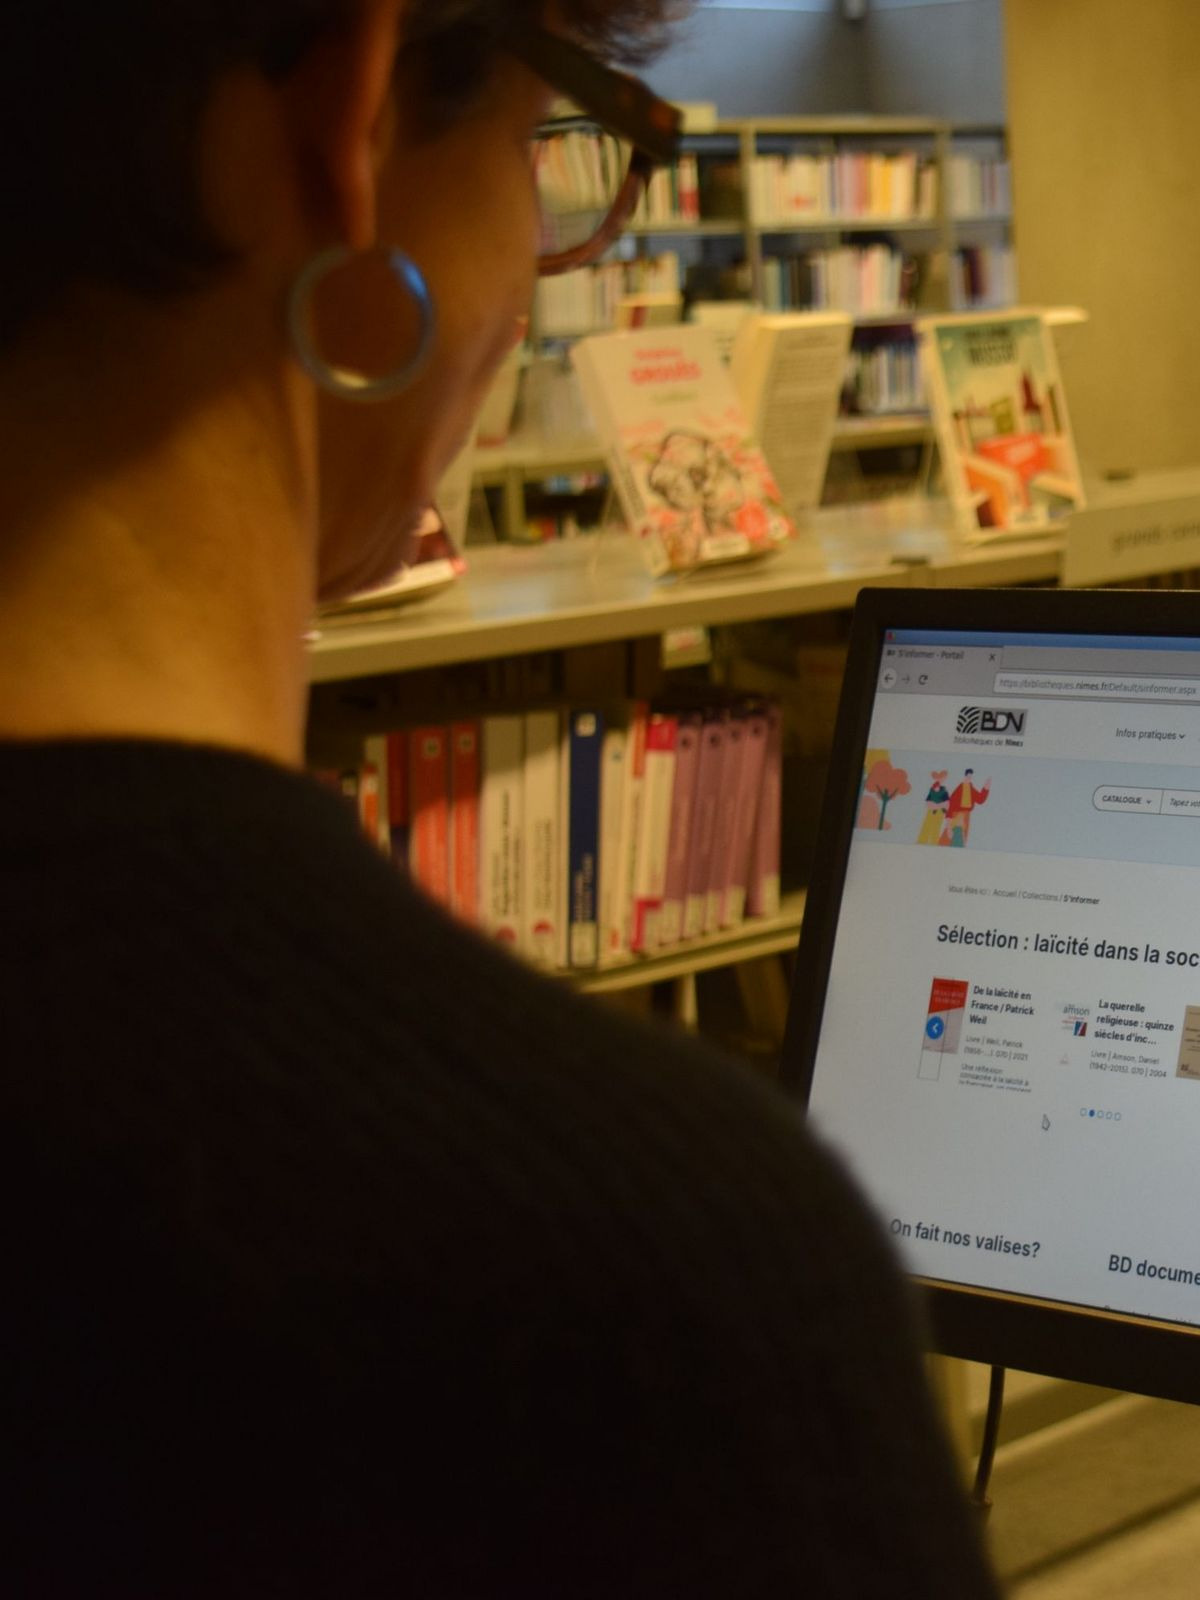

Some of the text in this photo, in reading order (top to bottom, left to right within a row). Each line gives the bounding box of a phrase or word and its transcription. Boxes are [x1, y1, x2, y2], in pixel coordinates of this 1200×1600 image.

[981, 710, 1024, 733] BDN
[1115, 728, 1177, 741] Infos pratiques
[1102, 793, 1142, 805] CATALOGUE
[1170, 797, 1189, 808] Tapez
[993, 888, 1018, 898] Accueil
[1022, 890, 1058, 901] Collections
[1063, 893, 1100, 904] S'informer
[937, 924, 1019, 951] Sélection
[1034, 932, 1088, 957] laïcité
[1094, 940, 1139, 962] dans
[1144, 943, 1160, 964] la
[973, 985, 1032, 1001] De la laïcité en
[971, 999, 1035, 1016] France Patrick
[1098, 999, 1146, 1013] La querelle
[969, 1014, 988, 1025] Weil
[1096, 1015, 1175, 1032] religieuse quinze
[966, 1035, 980, 1044] Livre
[1094, 1029, 1125, 1041] siècles
[1090, 1050, 1107, 1059] Livre
[1138, 1055, 1160, 1065] Daniel
[1149, 1069, 1167, 1079] 2004
[890, 1218, 1041, 1259] On fait nos valises?
[1108, 1253, 1133, 1274] BD
